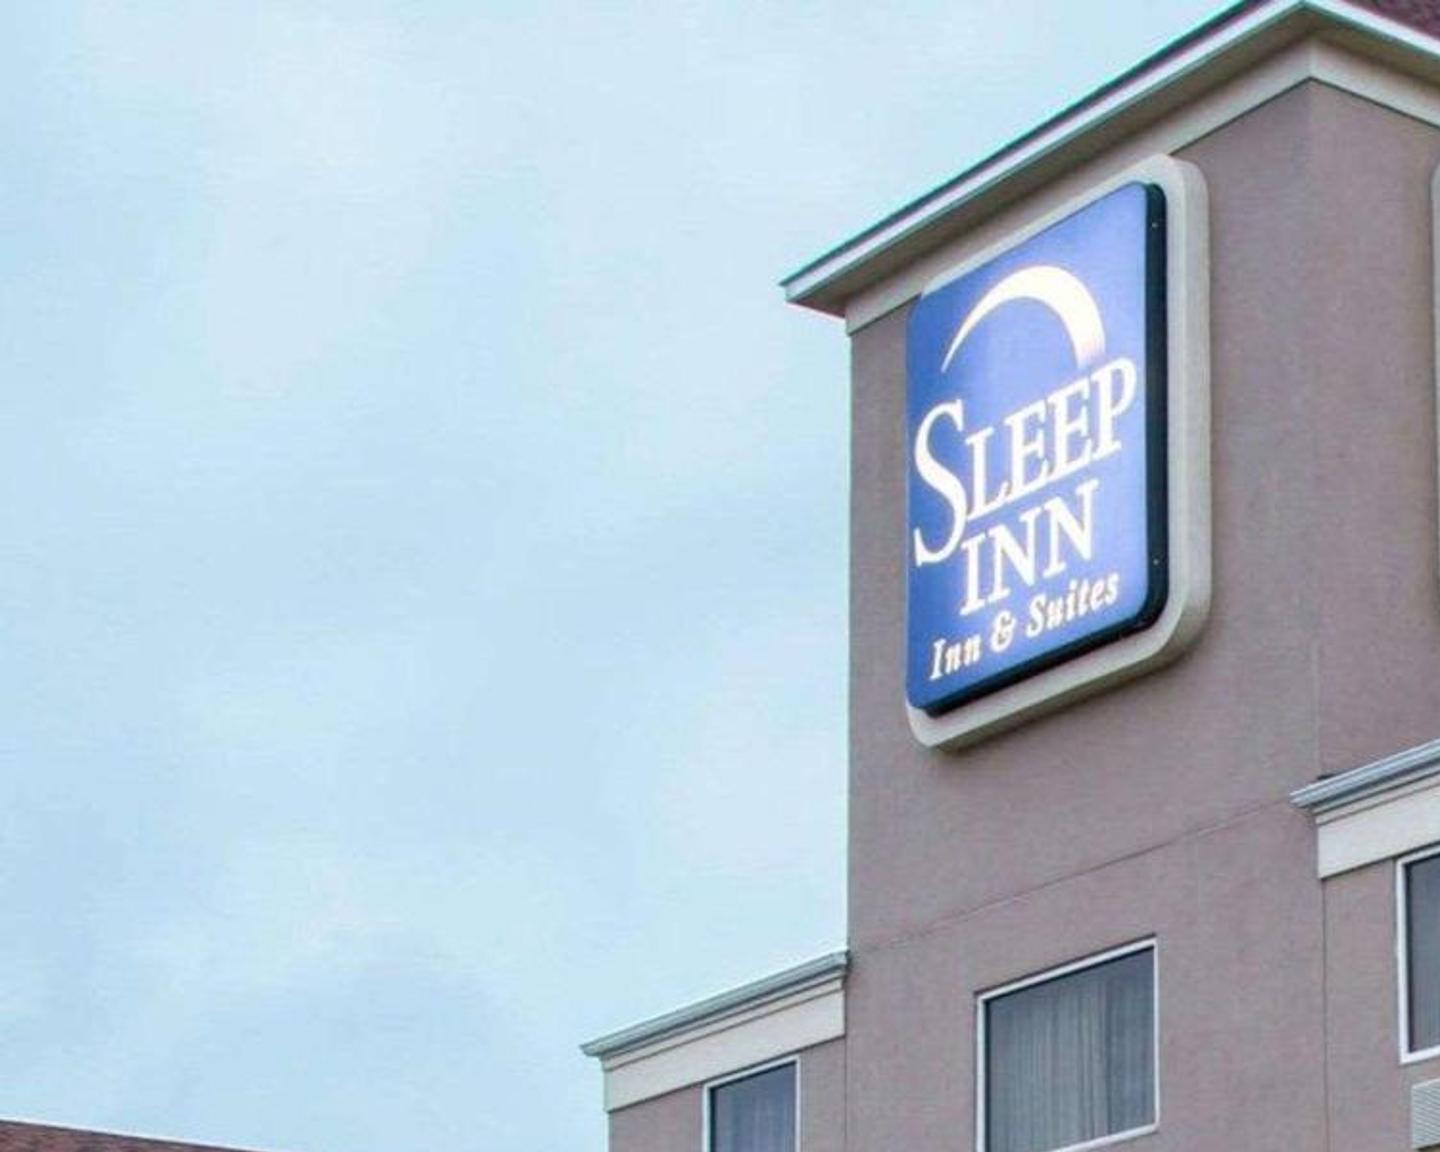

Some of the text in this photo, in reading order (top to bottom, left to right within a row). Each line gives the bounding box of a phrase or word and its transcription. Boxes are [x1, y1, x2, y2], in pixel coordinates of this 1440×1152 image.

[914, 357, 1137, 567] SLEEP
[960, 480, 1099, 617] INN
[929, 568, 1120, 681] Inn & Suites
